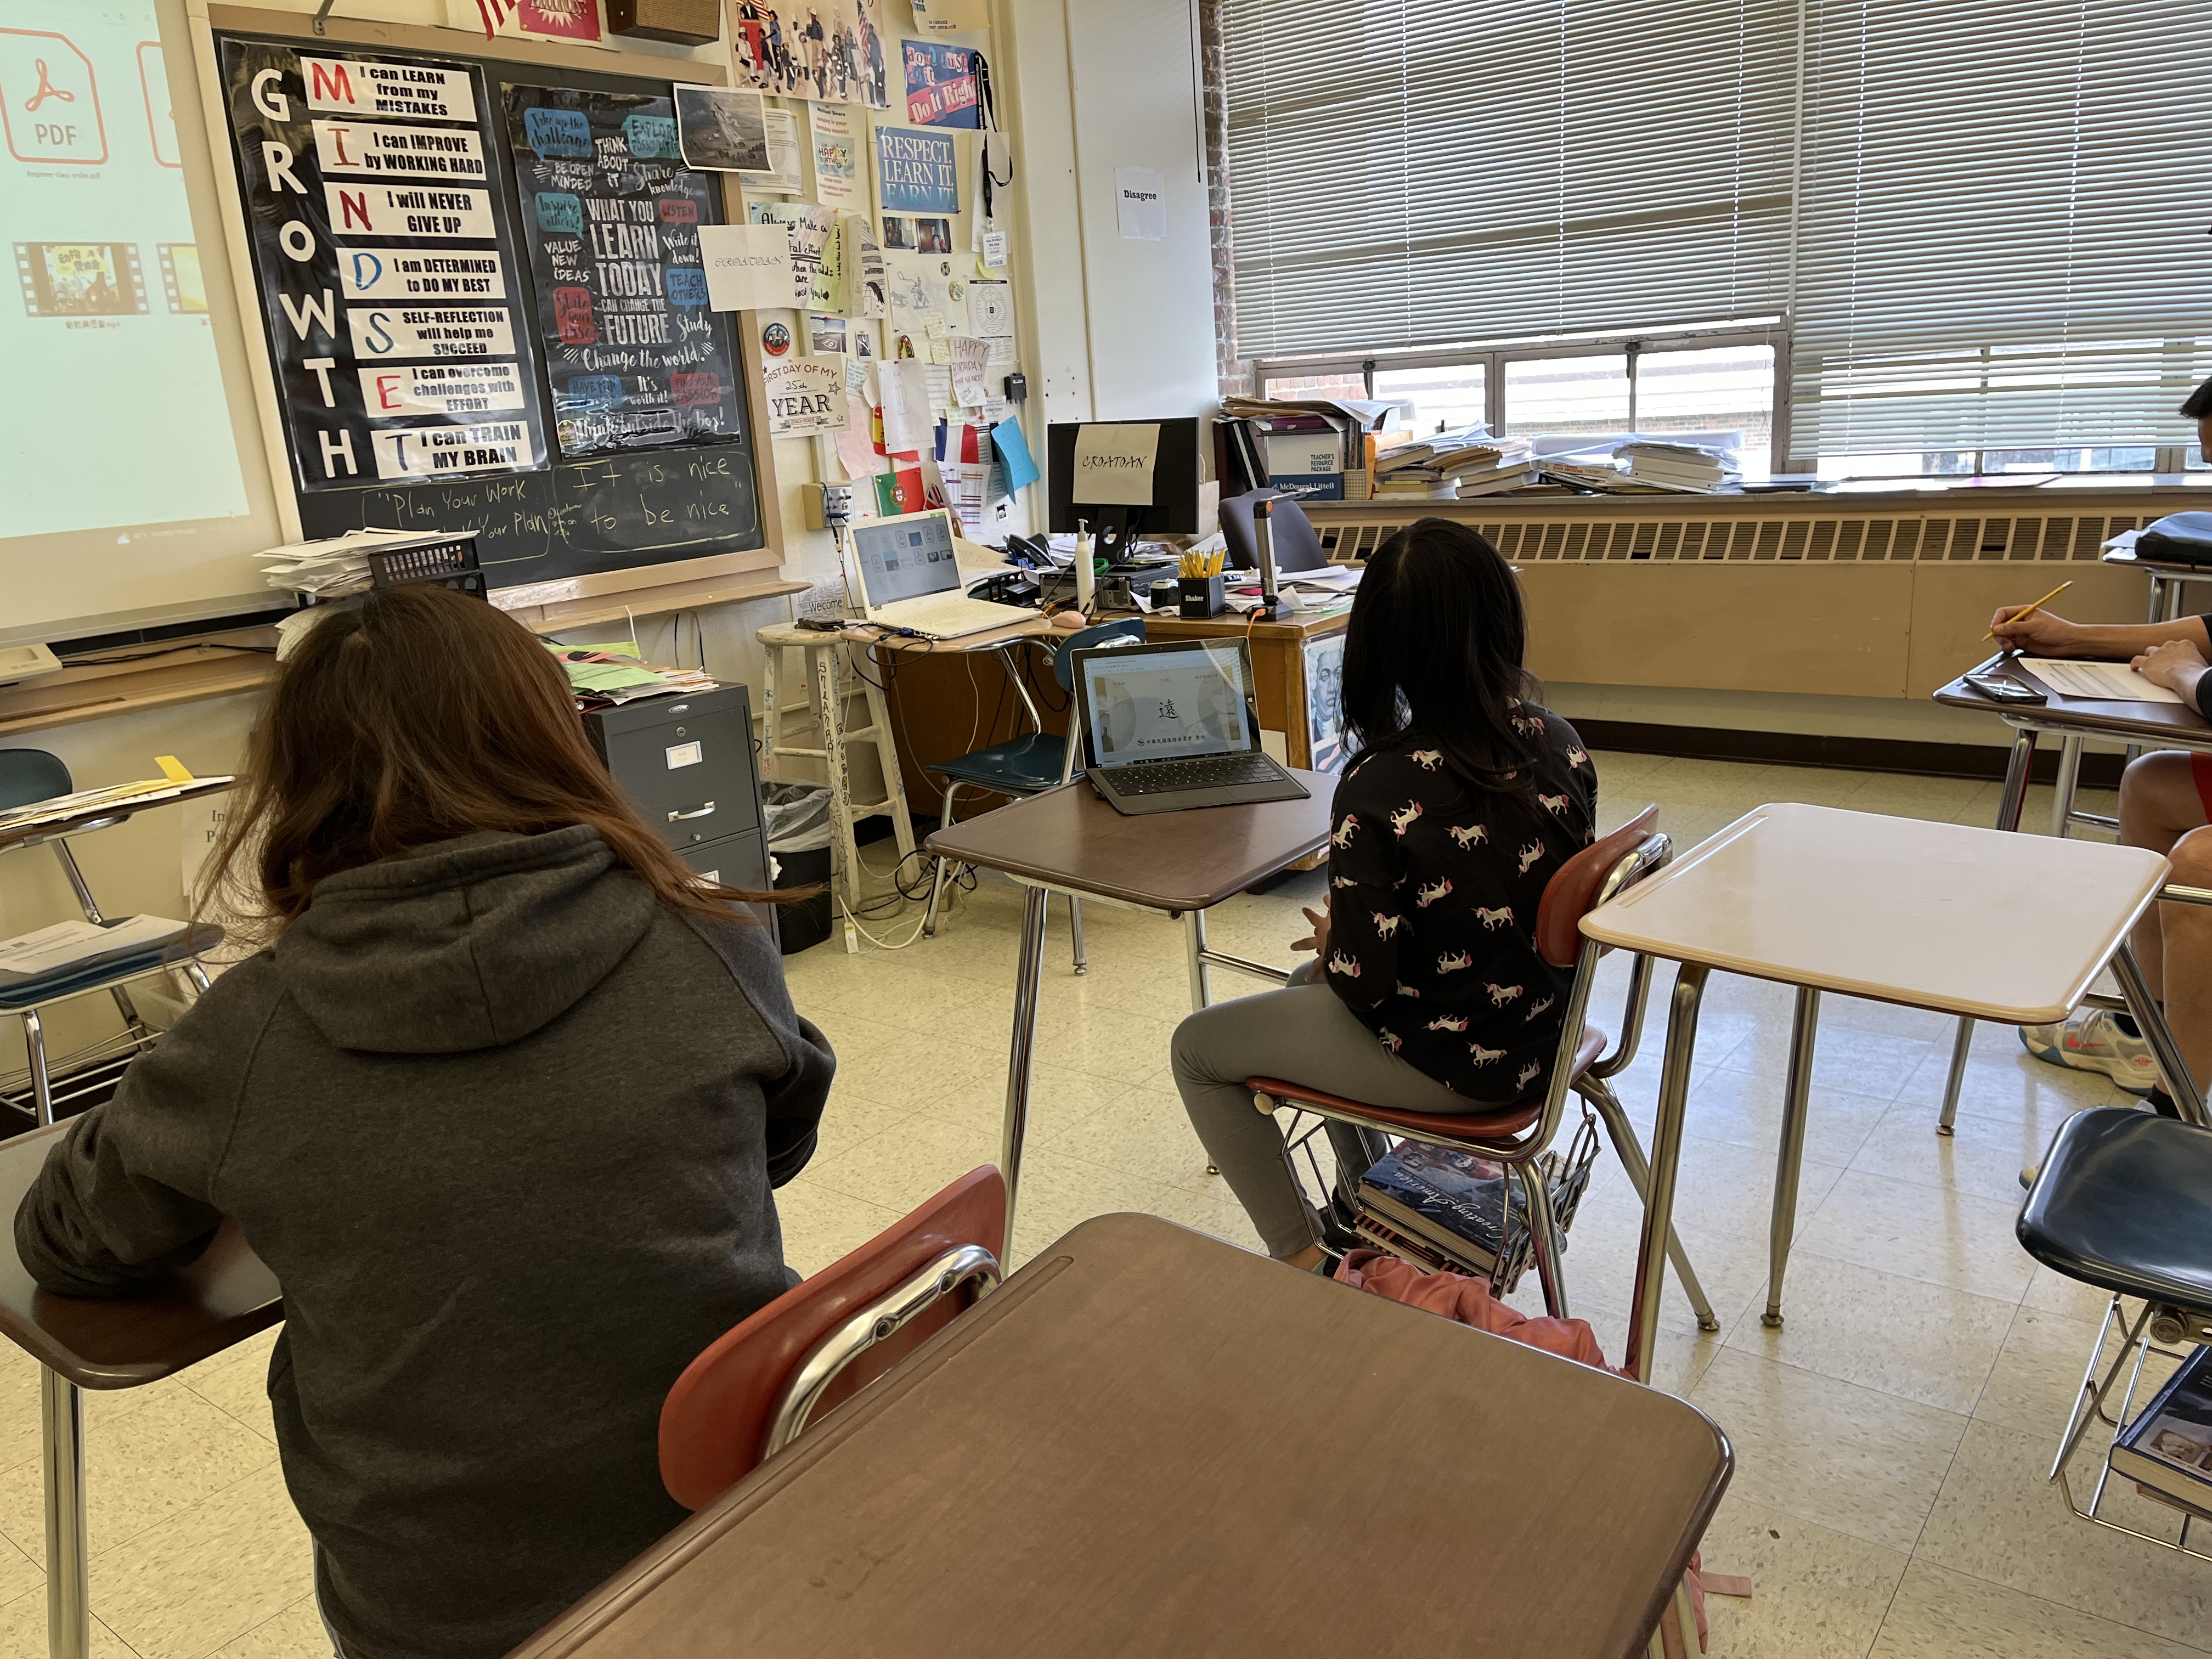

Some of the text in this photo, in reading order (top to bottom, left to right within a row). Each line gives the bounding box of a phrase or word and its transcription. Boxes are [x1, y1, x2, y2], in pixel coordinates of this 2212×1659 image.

[370, 69, 445, 85] can LEARN
[376, 83, 438, 100] from my
[376, 99, 448, 116] MISTAKES
[911, 102, 930, 123] Do
[929, 92, 942, 112] It
[531, 114, 552, 128] Take
[35, 123, 77, 146] PDF
[531, 127, 588, 150] challenge
[383, 135, 468, 153] can IMPROVE
[819, 146, 847, 157] HAPPY
[882, 136, 952, 163] RESPECT.
[365, 153, 483, 174] by WORKING HARD
[597, 154, 629, 171] ABOUT
[819, 156, 848, 165] BIRTHDAY
[555, 163, 594, 176] BE OPEN
[633, 162, 674, 191] Share
[884, 160, 954, 187] LEARN IT.
[647, 178, 693, 198] knowledge
[885, 183, 955, 208] EARN IT.
[1124, 190, 1156, 201] Disagree
[396, 193, 472, 211] will NEVER
[539, 196, 579, 214] Inspire
[585, 199, 654, 222] WHAT YOU
[663, 204, 694, 217] LISTEN
[408, 216, 461, 234] GIVE UP
[546, 215, 579, 229] others!
[544, 240, 582, 254] VALUE
[589, 224, 658, 258] LEARN
[663, 229, 698, 250] Write it
[672, 251, 699, 264] down!
[804, 244, 821, 256] effort
[402, 259, 496, 273] am DETERMINED
[552, 254, 577, 266] NEW
[819, 264, 833, 276] odds
[407, 279, 490, 292] to DO MY BEST
[595, 263, 663, 297] TODAY
[670, 274, 702, 287] TEACH
[795, 275, 809, 283] are
[672, 287, 706, 301] OTHERS
[556, 290, 588, 318] State
[601, 298, 667, 313] CAN CHANGE THE
[403, 312, 504, 324] SELF-REFLECTION
[676, 312, 713, 341] Study
[416, 328, 493, 341] will help me
[603, 314, 673, 345] FUTURE
[433, 343, 487, 354] SUCCEED
[581, 342, 705, 372] Change the world.
[954, 340, 989, 358] HAPPY
[421, 366, 509, 379] can overcome
[783, 364, 801, 374] DAY
[821, 368, 837, 378] MY
[952, 361, 983, 377] BIRTHDAY
[413, 381, 514, 396] challenges with
[573, 381, 597, 393] HAVE
[637, 375, 658, 392] It's
[955, 374, 983, 387] MR SEARS!
[630, 392, 654, 405] worth
[657, 390, 668, 404] it!
[675, 387, 717, 402] PASSION
[447, 399, 488, 411] EFFORT
[772, 394, 832, 417] YEAR
[432, 424, 521, 446] can TRAIN
[432, 447, 517, 469] MY BRAIN
[1082, 455, 1147, 470] CROATOAN
[647, 461, 664, 483] is
[689, 455, 730, 481] nice
[442, 489, 477, 511] Your
[486, 479, 526, 503] Work
[590, 507, 616, 534] to
[640, 493, 675, 526] be
[478, 514, 507, 539] Your
[514, 510, 549, 536] Plan
[809, 599, 843, 613] Welcome
[1158, 699, 1179, 719] 遠
[1394, 1172, 1454, 1204] America
[1452, 1203, 1505, 1239] Creating
